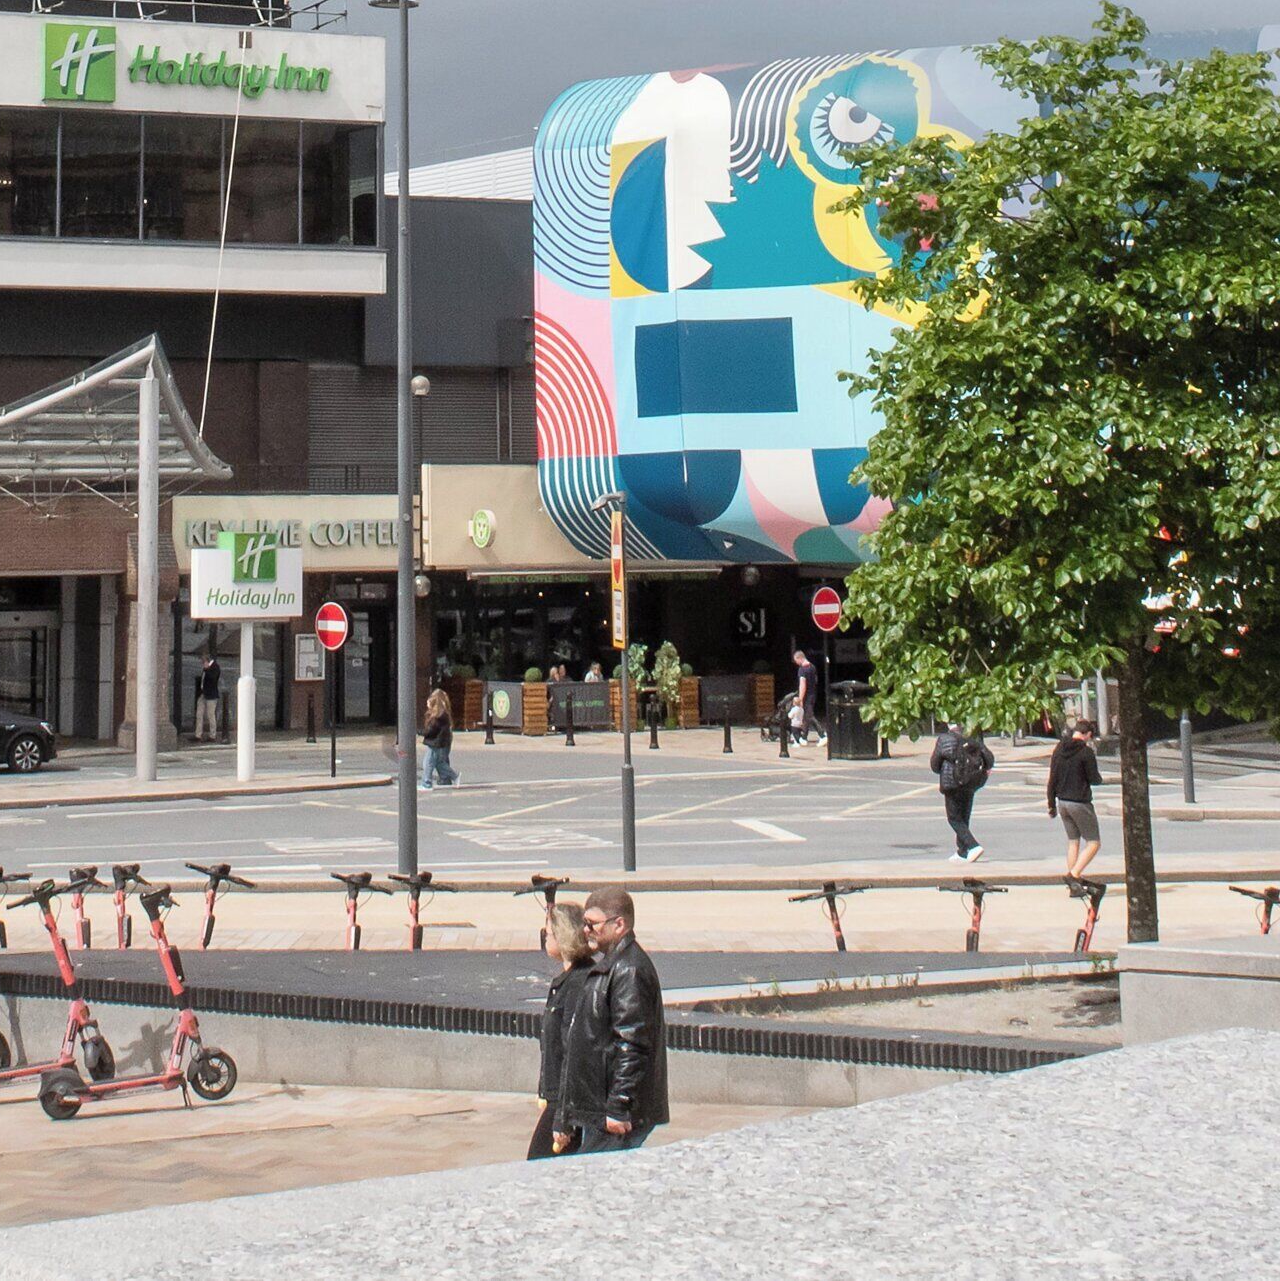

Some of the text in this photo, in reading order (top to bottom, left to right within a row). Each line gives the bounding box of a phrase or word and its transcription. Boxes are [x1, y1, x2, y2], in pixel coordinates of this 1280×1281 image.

[128, 44, 331, 99] Holiday Inn
[207, 587, 295, 610] Holiday Inn
